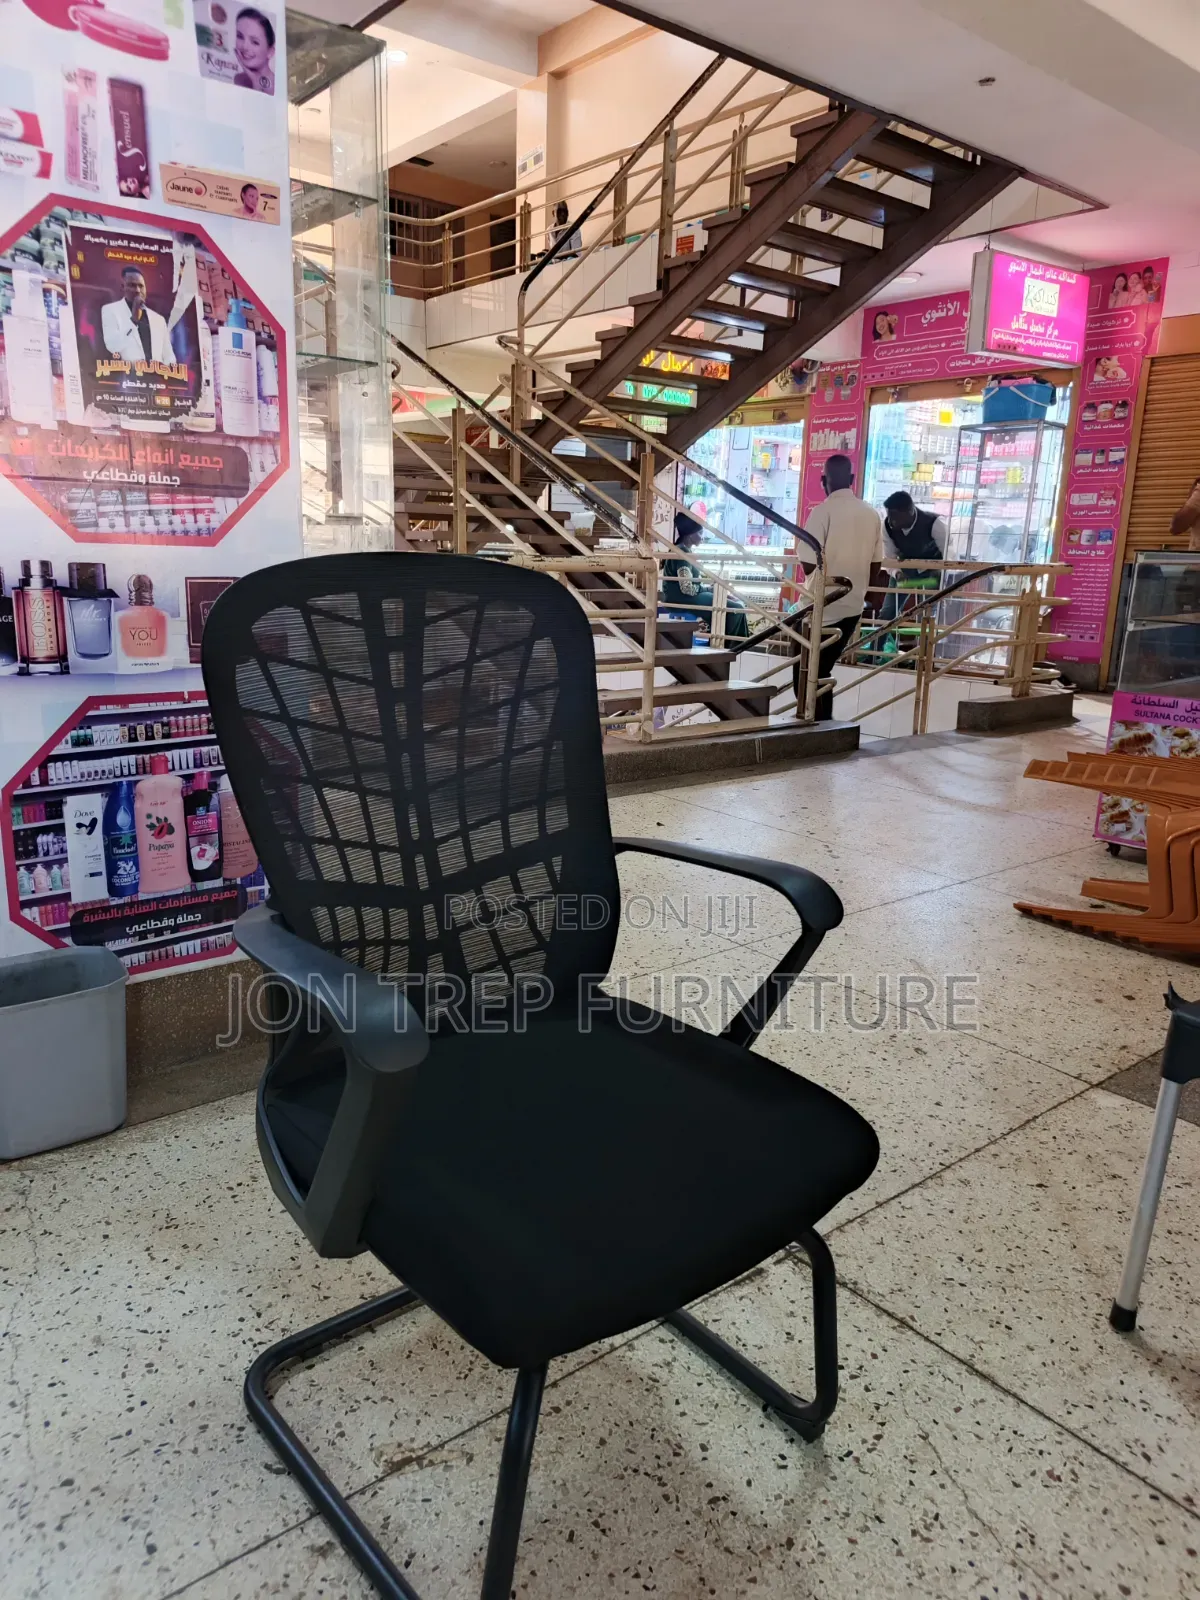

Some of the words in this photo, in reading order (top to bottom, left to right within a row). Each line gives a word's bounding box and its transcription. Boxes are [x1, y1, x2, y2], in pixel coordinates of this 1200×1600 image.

[169, 182, 194, 194] Jaune
[262, 200, 268, 211] 7
[921, 300, 961, 326] الأنثوي
[95, 352, 132, 377] بشير
[47, 438, 129, 464] الكريمات
[132, 446, 174, 465] انواع
[178, 453, 224, 470] جميع
[83, 469, 147, 486] وقطاعي
[148, 470, 181, 486] جملة
[29, 597, 48, 651] BOSS
[129, 628, 158, 641] YOU
[1130, 694, 1179, 709] السلطانة
[1134, 709, 1171, 720] SULTANA
[1173, 714, 1200, 724] COCK
[73, 809, 95, 819] Dove
[192, 817, 213, 826] ONION
[148, 842, 175, 852] Papaya
[159, 894, 209, 910] مستلزمات
[211, 889, 238, 903] جميع
[82, 908, 122, 923] بالبشرة
[123, 901, 157, 917] العناية
[125, 917, 175, 934] وقطاعي
[176, 912, 202, 925] جملة
